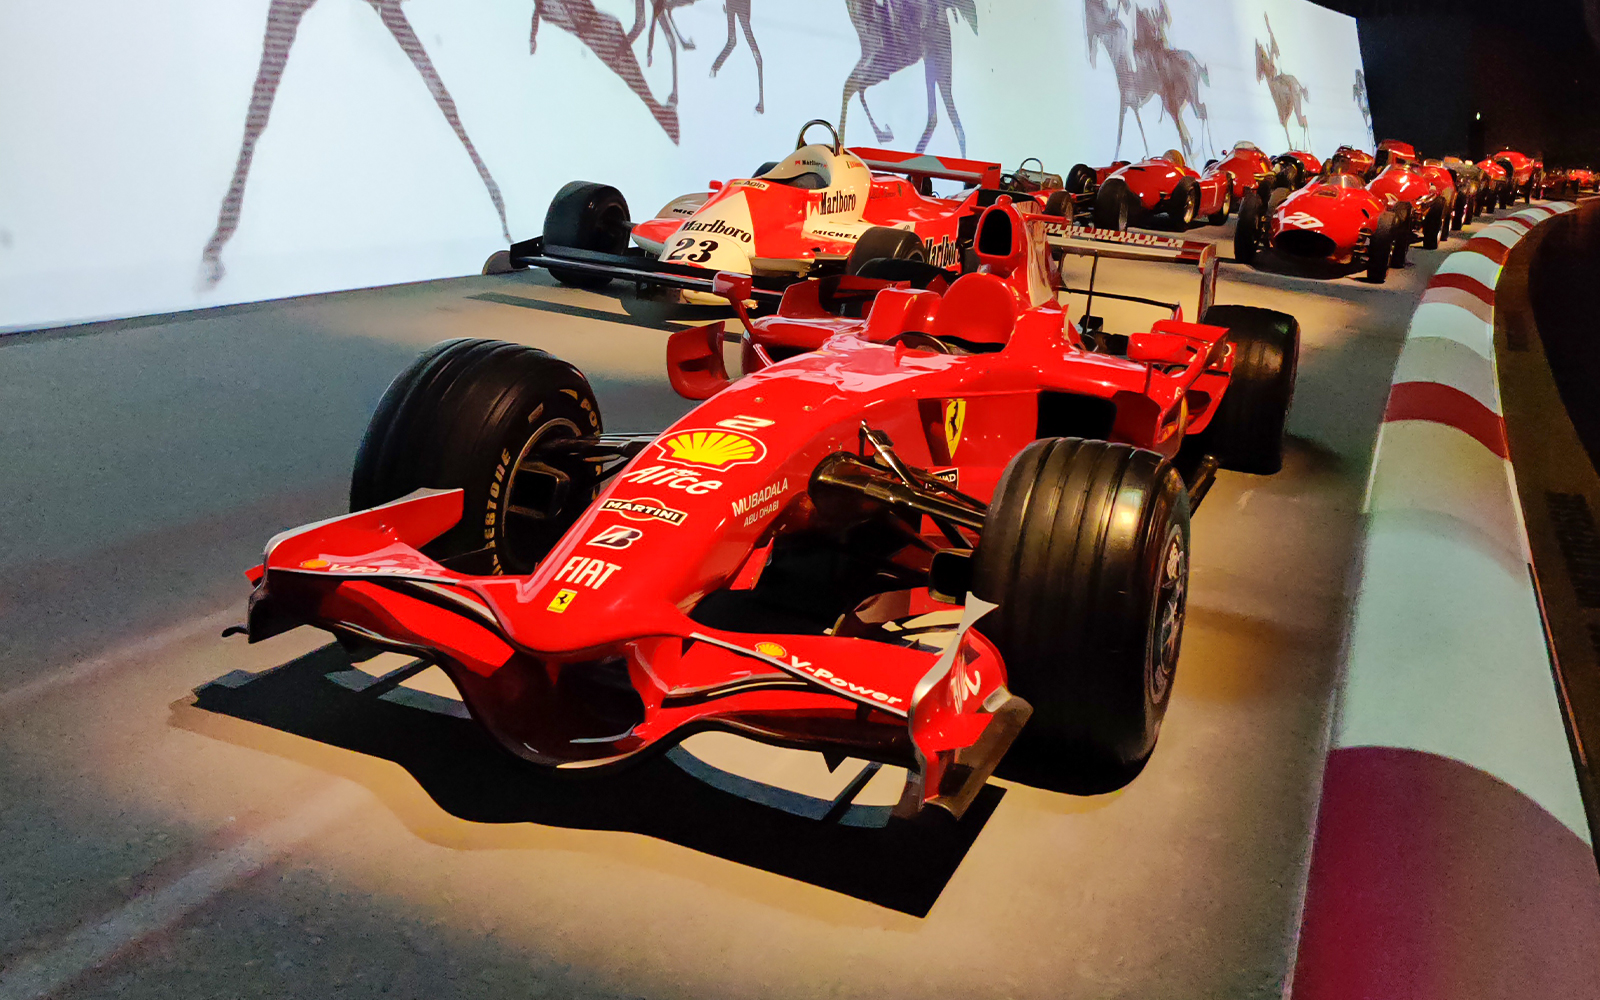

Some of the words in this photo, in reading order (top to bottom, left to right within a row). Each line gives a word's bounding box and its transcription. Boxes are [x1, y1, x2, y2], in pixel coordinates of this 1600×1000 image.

[743, 180, 766, 190] Agip
[820, 190, 857, 215] Marlboro
[682, 219, 752, 243] Marlboro
[1279, 211, 1325, 230] 20
[812, 229, 858, 240] MICHEL
[667, 237, 719, 263] 23
[621, 465, 723, 495] Alice
[731, 477, 789, 518] MUBADALA
[605, 501, 680, 522] MARTINI
[743, 511, 759, 528] ABU
[759, 499, 780, 519] DHABI
[553, 555, 622, 590] FIAT
[790, 655, 903, 705] V-Power
